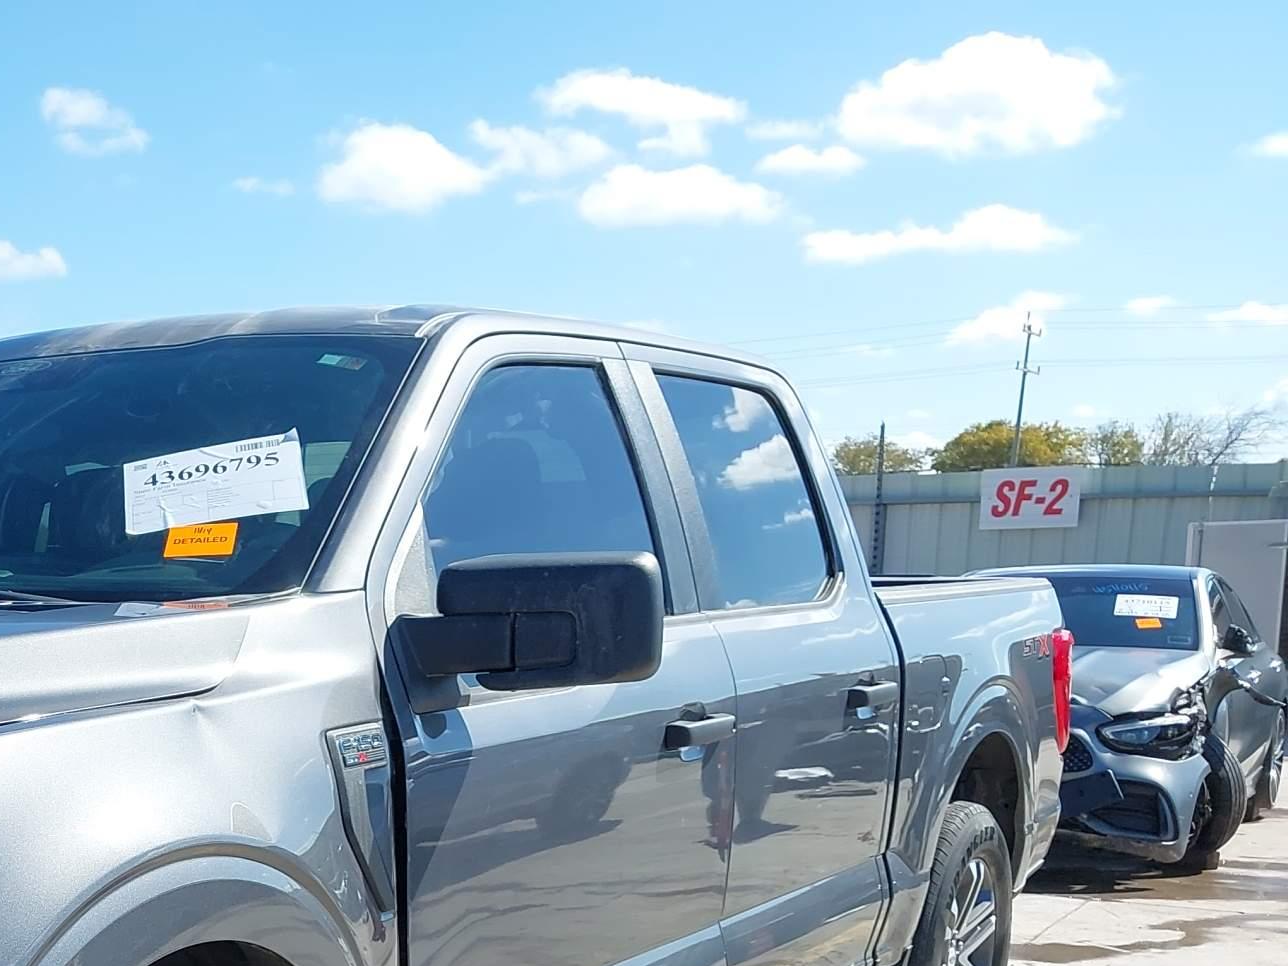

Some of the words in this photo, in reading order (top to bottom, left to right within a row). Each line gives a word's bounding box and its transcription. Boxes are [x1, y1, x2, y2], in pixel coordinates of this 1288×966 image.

[143, 451, 280, 487] 43696795
[991, 478, 1069, 517] SF-2
[173, 536, 229, 545] DETAILED
[1023, 635, 1050, 658] STX
